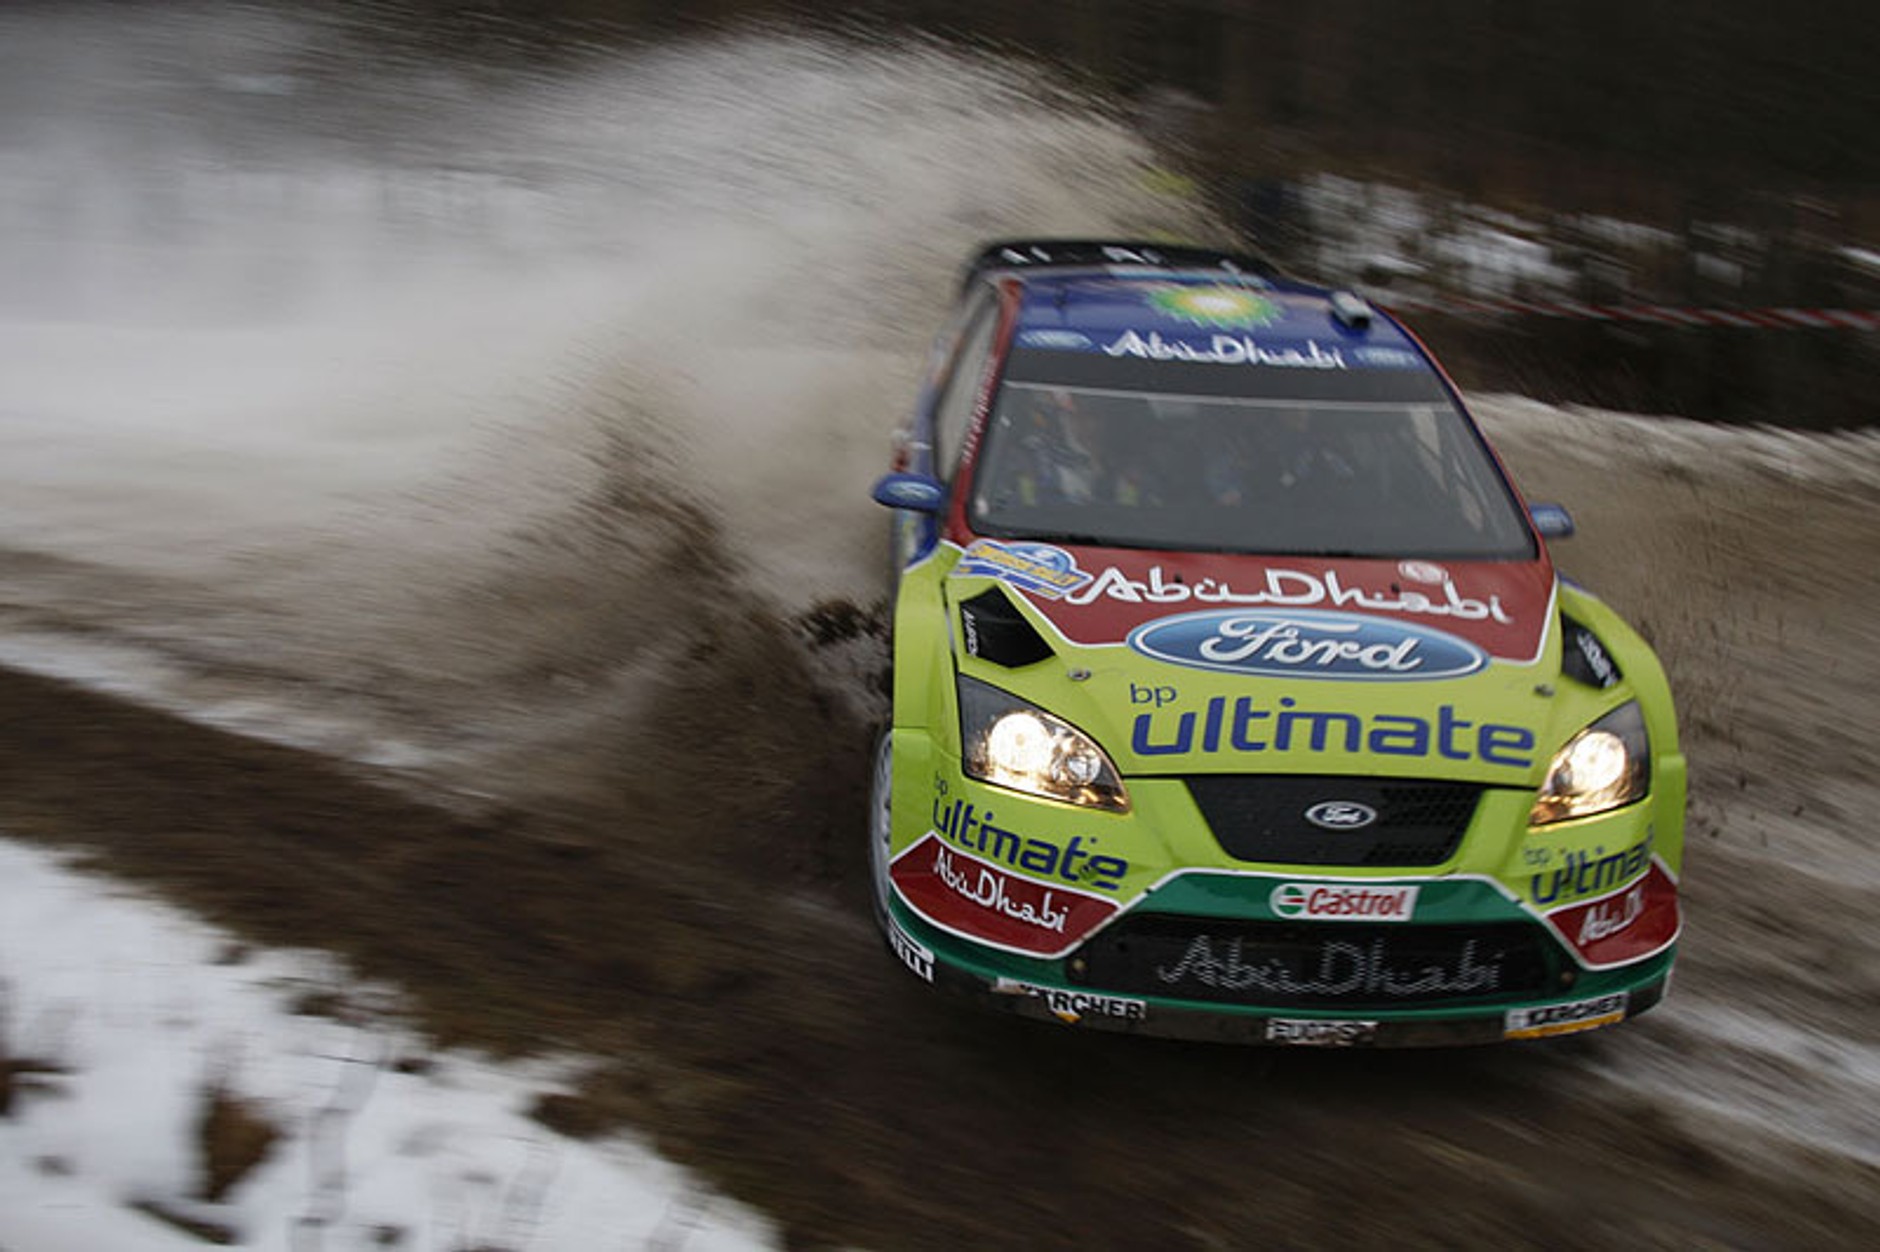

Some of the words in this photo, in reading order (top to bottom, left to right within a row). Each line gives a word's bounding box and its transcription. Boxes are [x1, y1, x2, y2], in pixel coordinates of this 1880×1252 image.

[1199, 617, 1422, 672] Ford
[1130, 683, 1177, 708] bp
[1131, 696, 1536, 768] ultimate
[933, 797, 1129, 891] ultimate
[1307, 887, 1408, 916] Castrol
